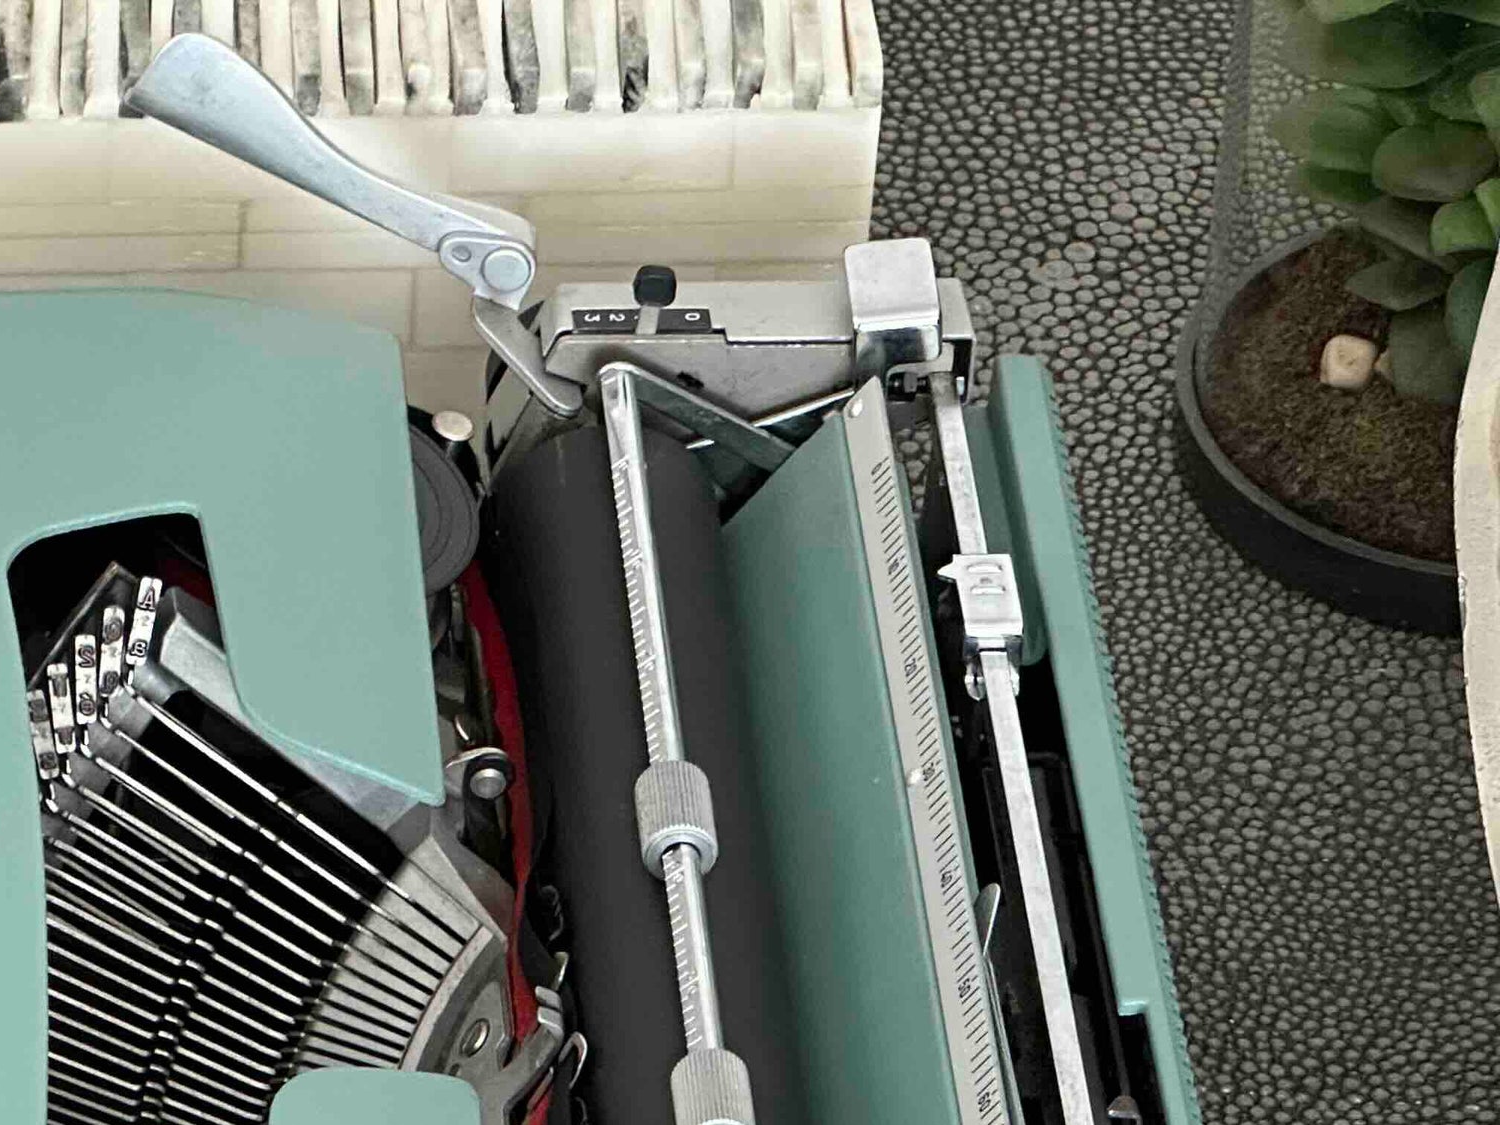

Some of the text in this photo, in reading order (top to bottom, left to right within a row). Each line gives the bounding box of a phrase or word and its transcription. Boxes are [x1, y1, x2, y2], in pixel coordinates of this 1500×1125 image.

[584, 313, 601, 322] 3
[608, 313, 626, 322] 2
[684, 312, 701, 322] 0
[903, 659, 919, 676] 20
[939, 869, 955, 889] 40
[956, 979, 972, 999] 50
[977, 1092, 992, 1112] 60
